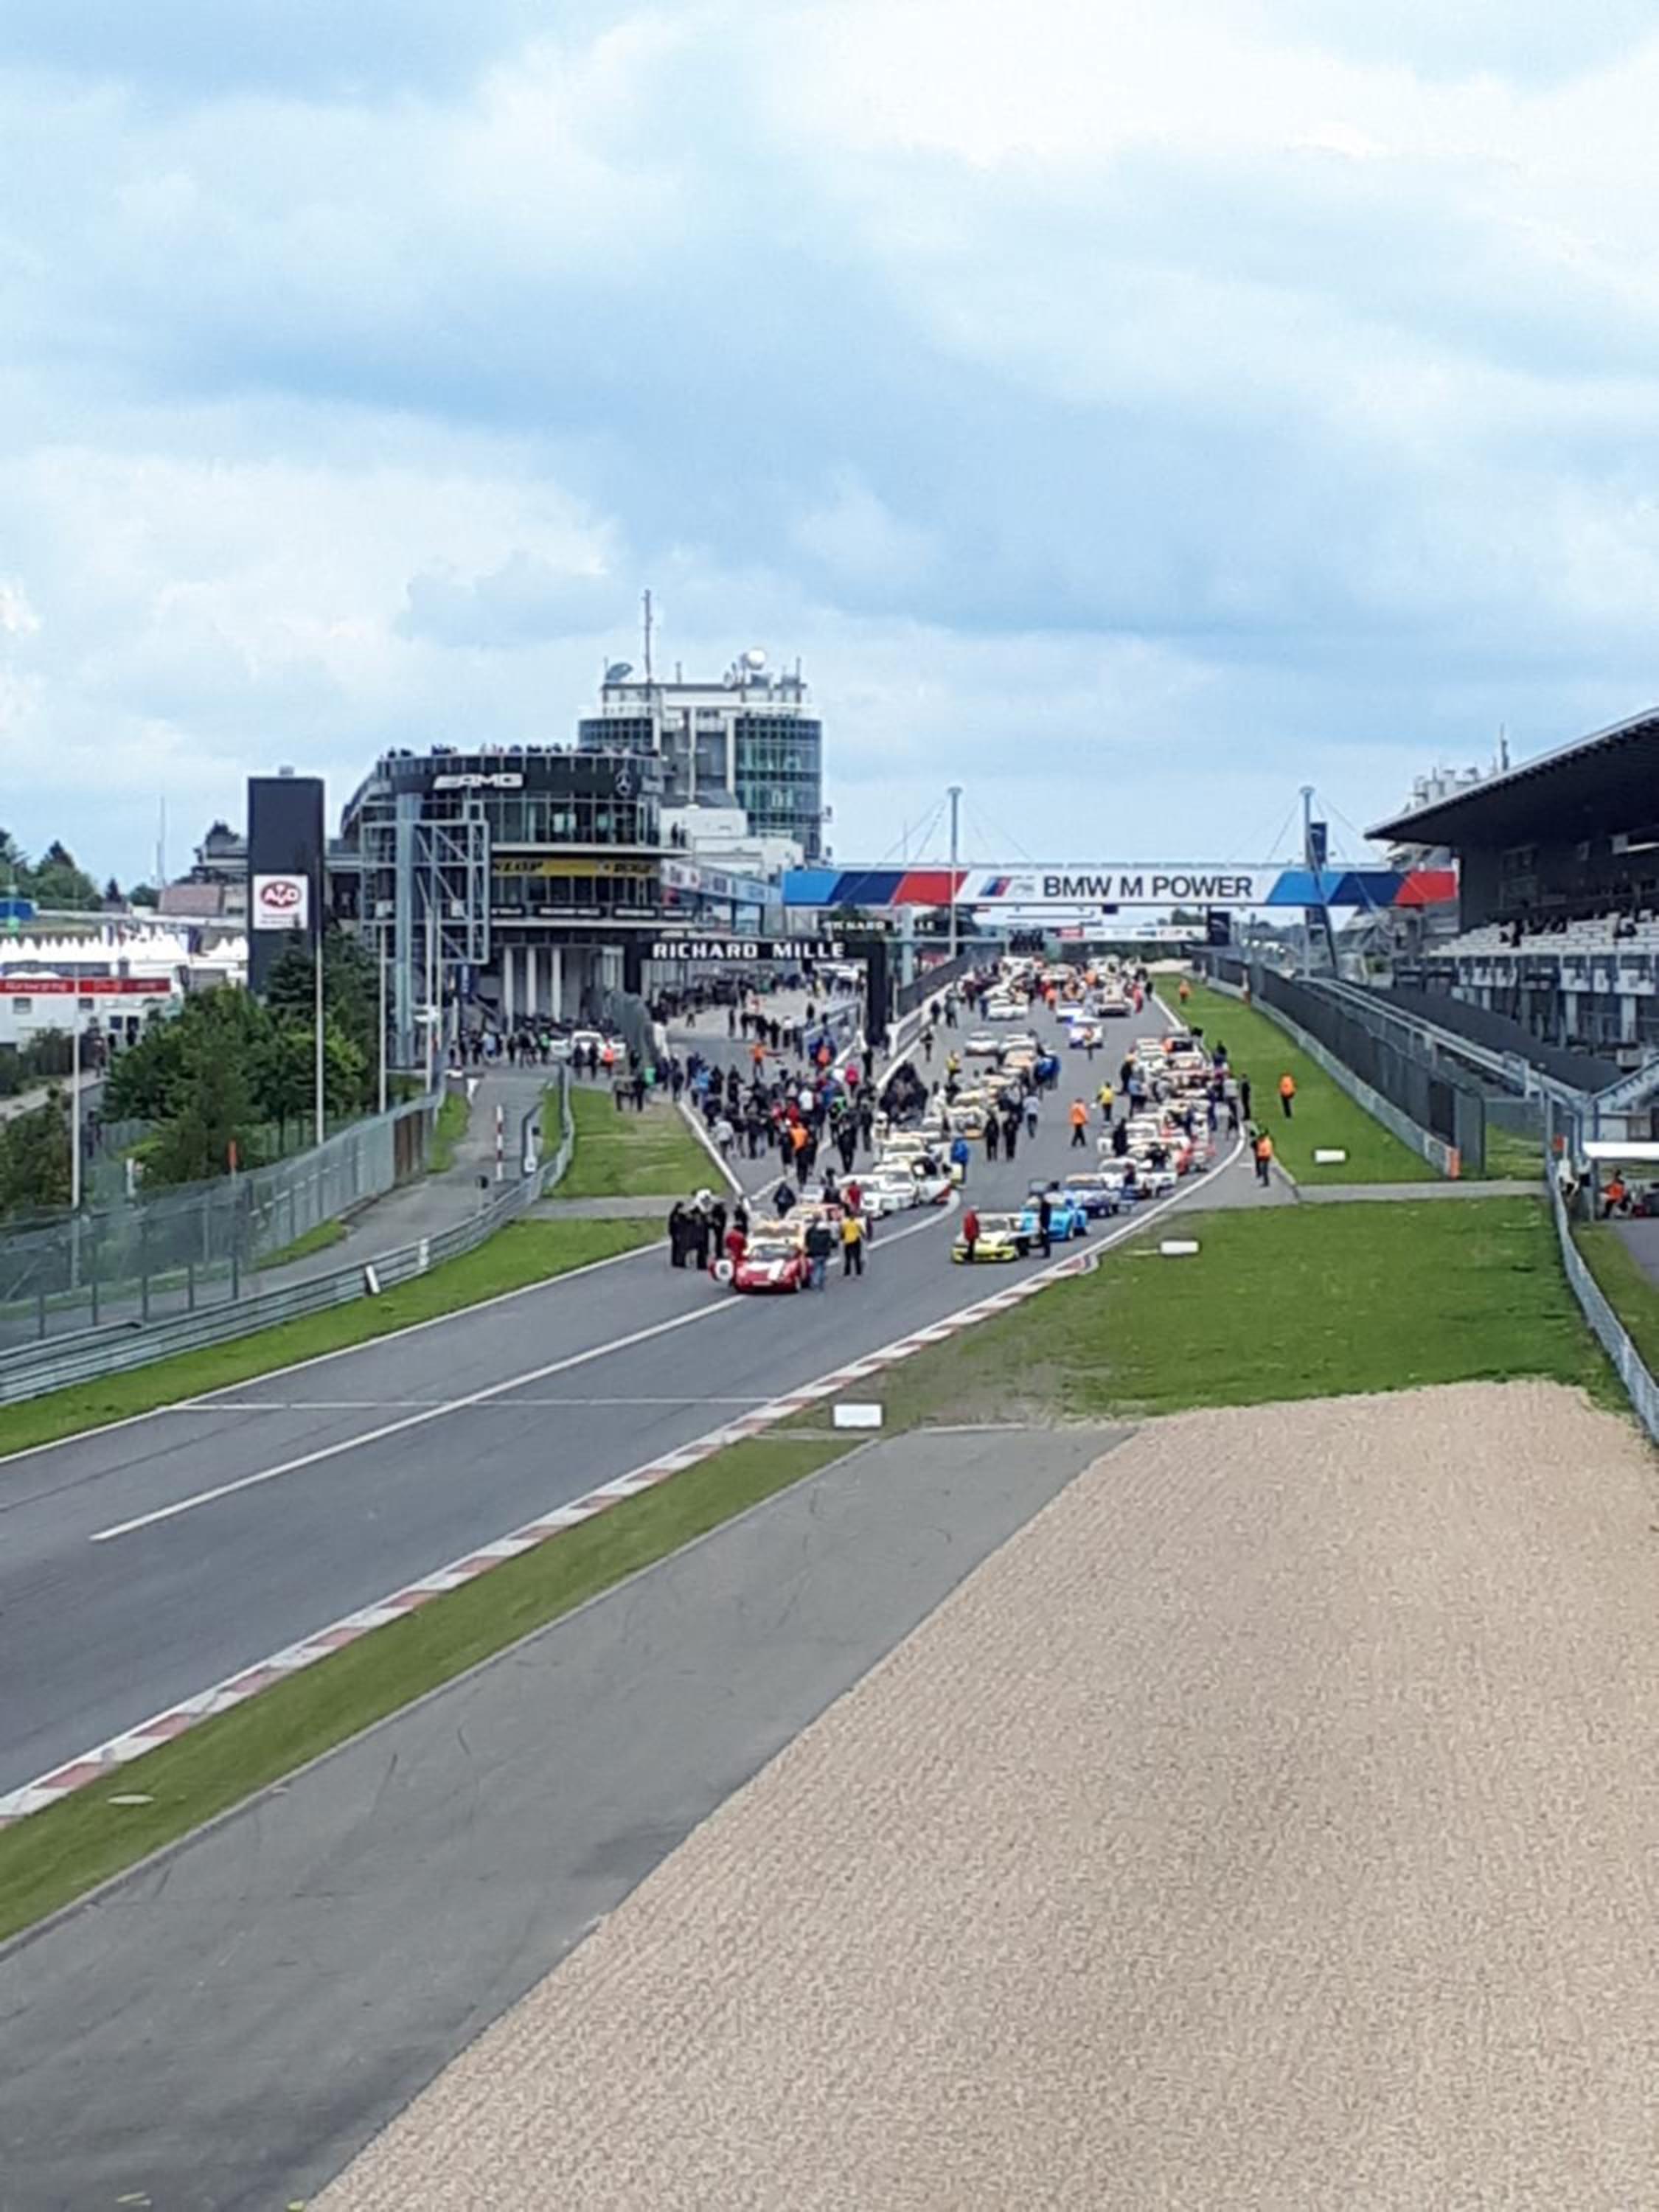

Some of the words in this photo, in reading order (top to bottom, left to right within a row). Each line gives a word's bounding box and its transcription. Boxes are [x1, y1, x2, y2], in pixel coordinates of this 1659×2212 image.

[1043, 876, 1111, 897] BMW
[1120, 876, 1142, 897] M
[1152, 876, 1252, 897] POWER
[653, 942, 758, 959] RICHARD
[773, 942, 844, 959] MILLE
